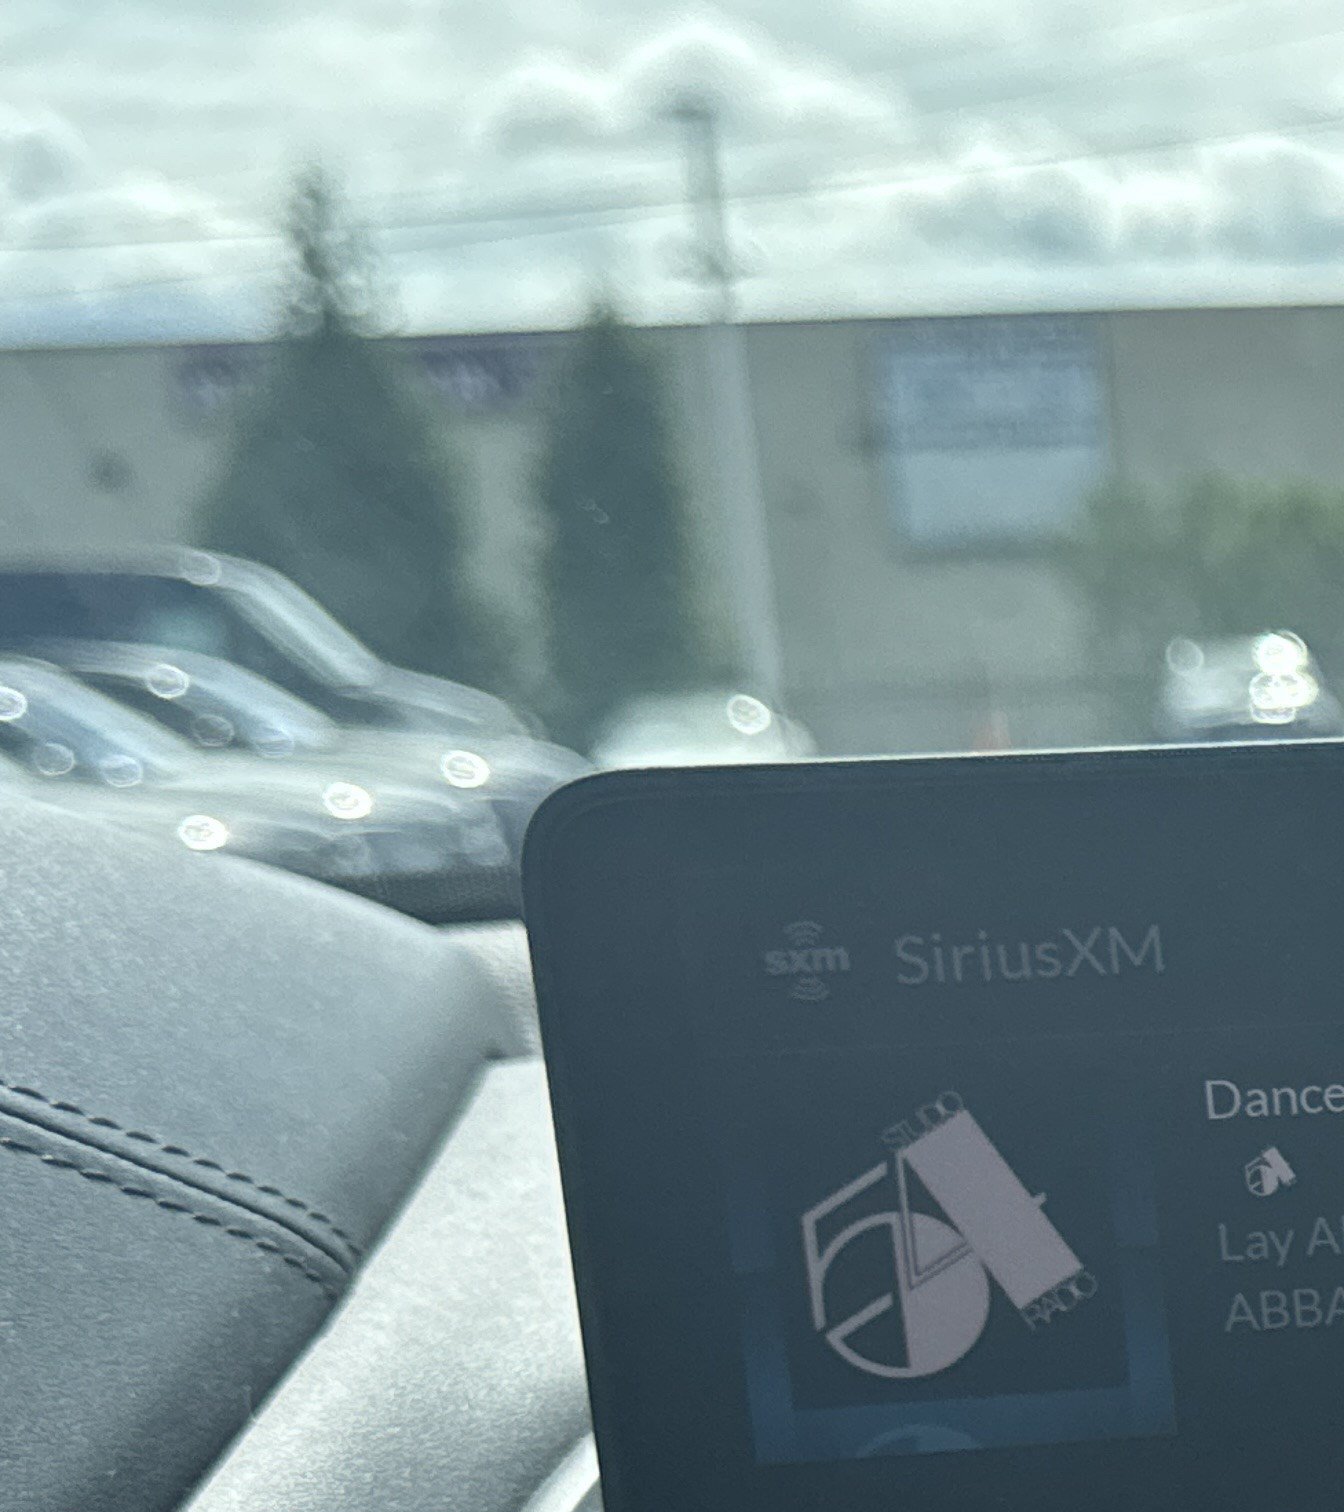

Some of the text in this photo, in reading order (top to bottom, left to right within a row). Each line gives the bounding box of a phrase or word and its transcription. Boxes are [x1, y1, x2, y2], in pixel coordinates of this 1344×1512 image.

[764, 946, 852, 976] sxm
[894, 923, 1166, 986] SiriusXM
[1217, 1222, 1295, 1267] Lay
